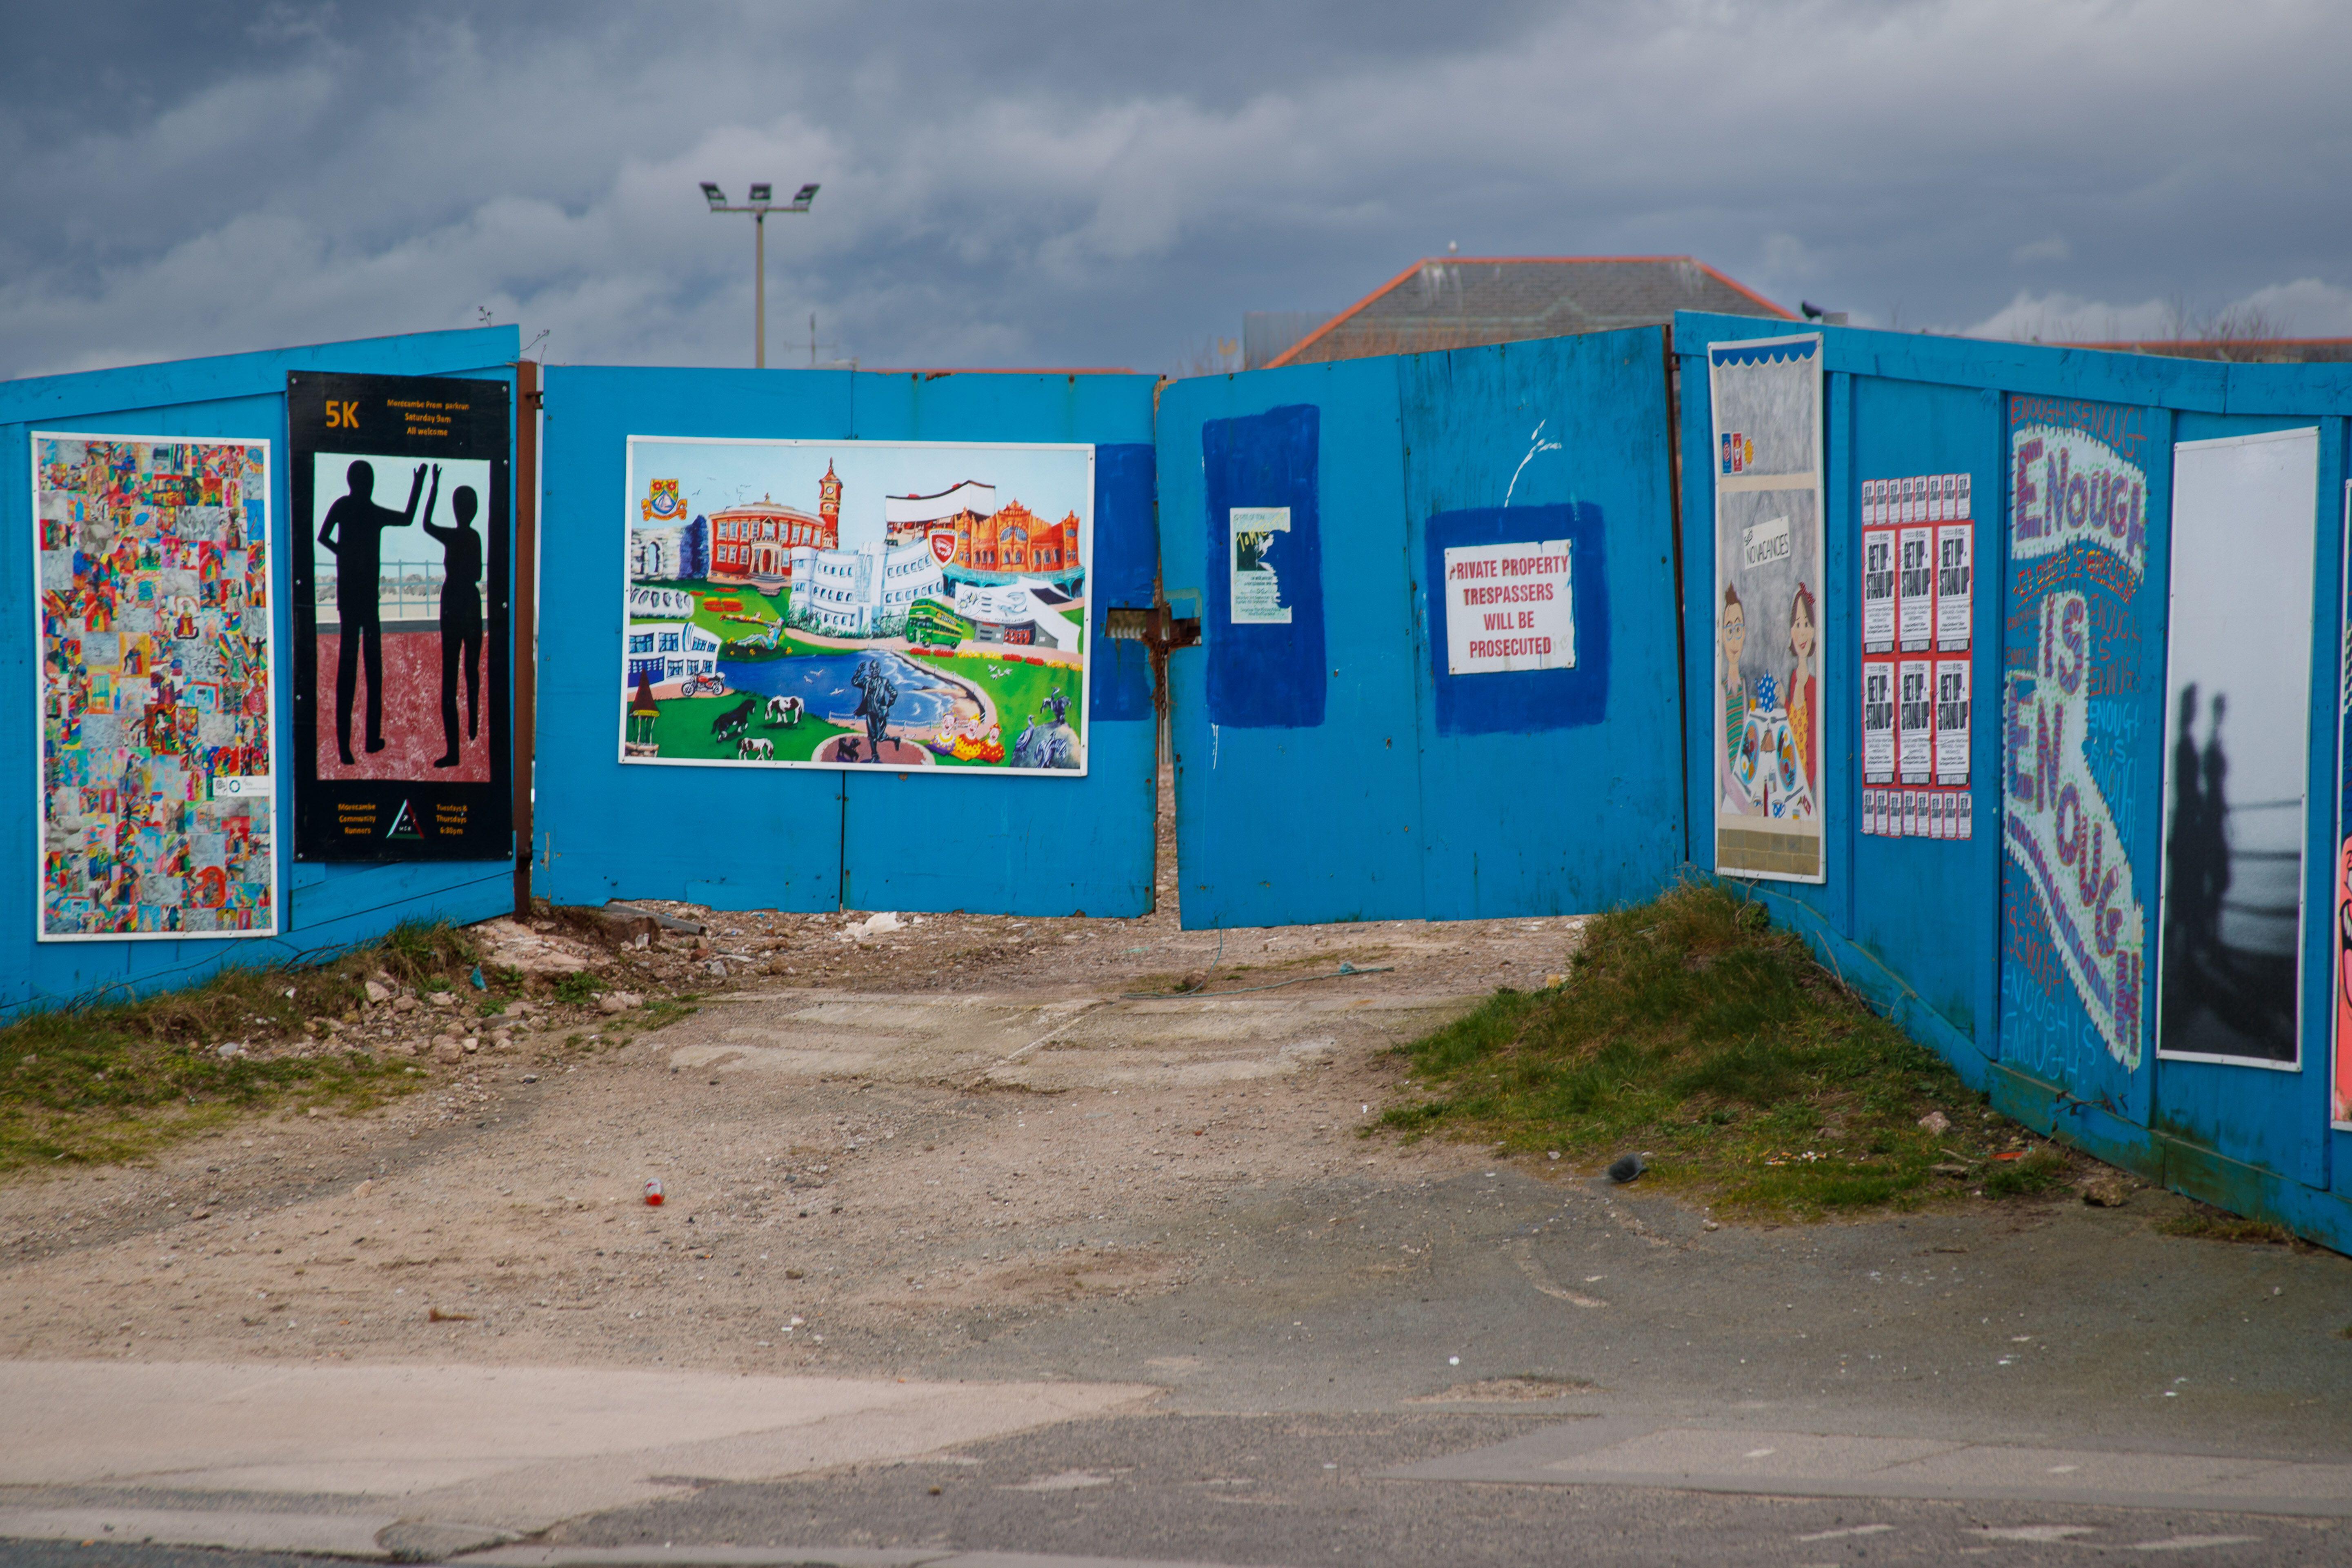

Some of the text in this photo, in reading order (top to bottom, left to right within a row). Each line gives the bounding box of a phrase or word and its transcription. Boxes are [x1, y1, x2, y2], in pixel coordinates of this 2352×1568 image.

[326, 400, 360, 428] 5K
[387, 399, 469, 411] Morecambe Prom parkrun
[2011, 396, 2067, 427] ENOUGH
[405, 412, 451, 423] Saturday 9am
[407, 426, 449, 436] All welcome
[1502, 555, 1569, 576] PROPERTY
[1866, 571, 1885, 600] STAND
[1902, 569, 1921, 598] STAND
[1939, 567, 1960, 597] STAND
[1463, 583, 1554, 606] TRESPASSERS
[1483, 611, 1535, 631] WILL BE
[1469, 636, 1551, 658] PROSECUTED
[2044, 589, 2084, 695] IS
[1866, 703, 1884, 731] STAND
[1901, 702, 1921, 731] STAND
[1938, 702, 1959, 731] STAND
[338, 803, 376, 811] Morecambe
[436, 804, 462, 812] Tuesdays
[339, 815, 376, 824] Community
[436, 814, 467, 824] Thursdays
[345, 826, 372, 835] Runners
